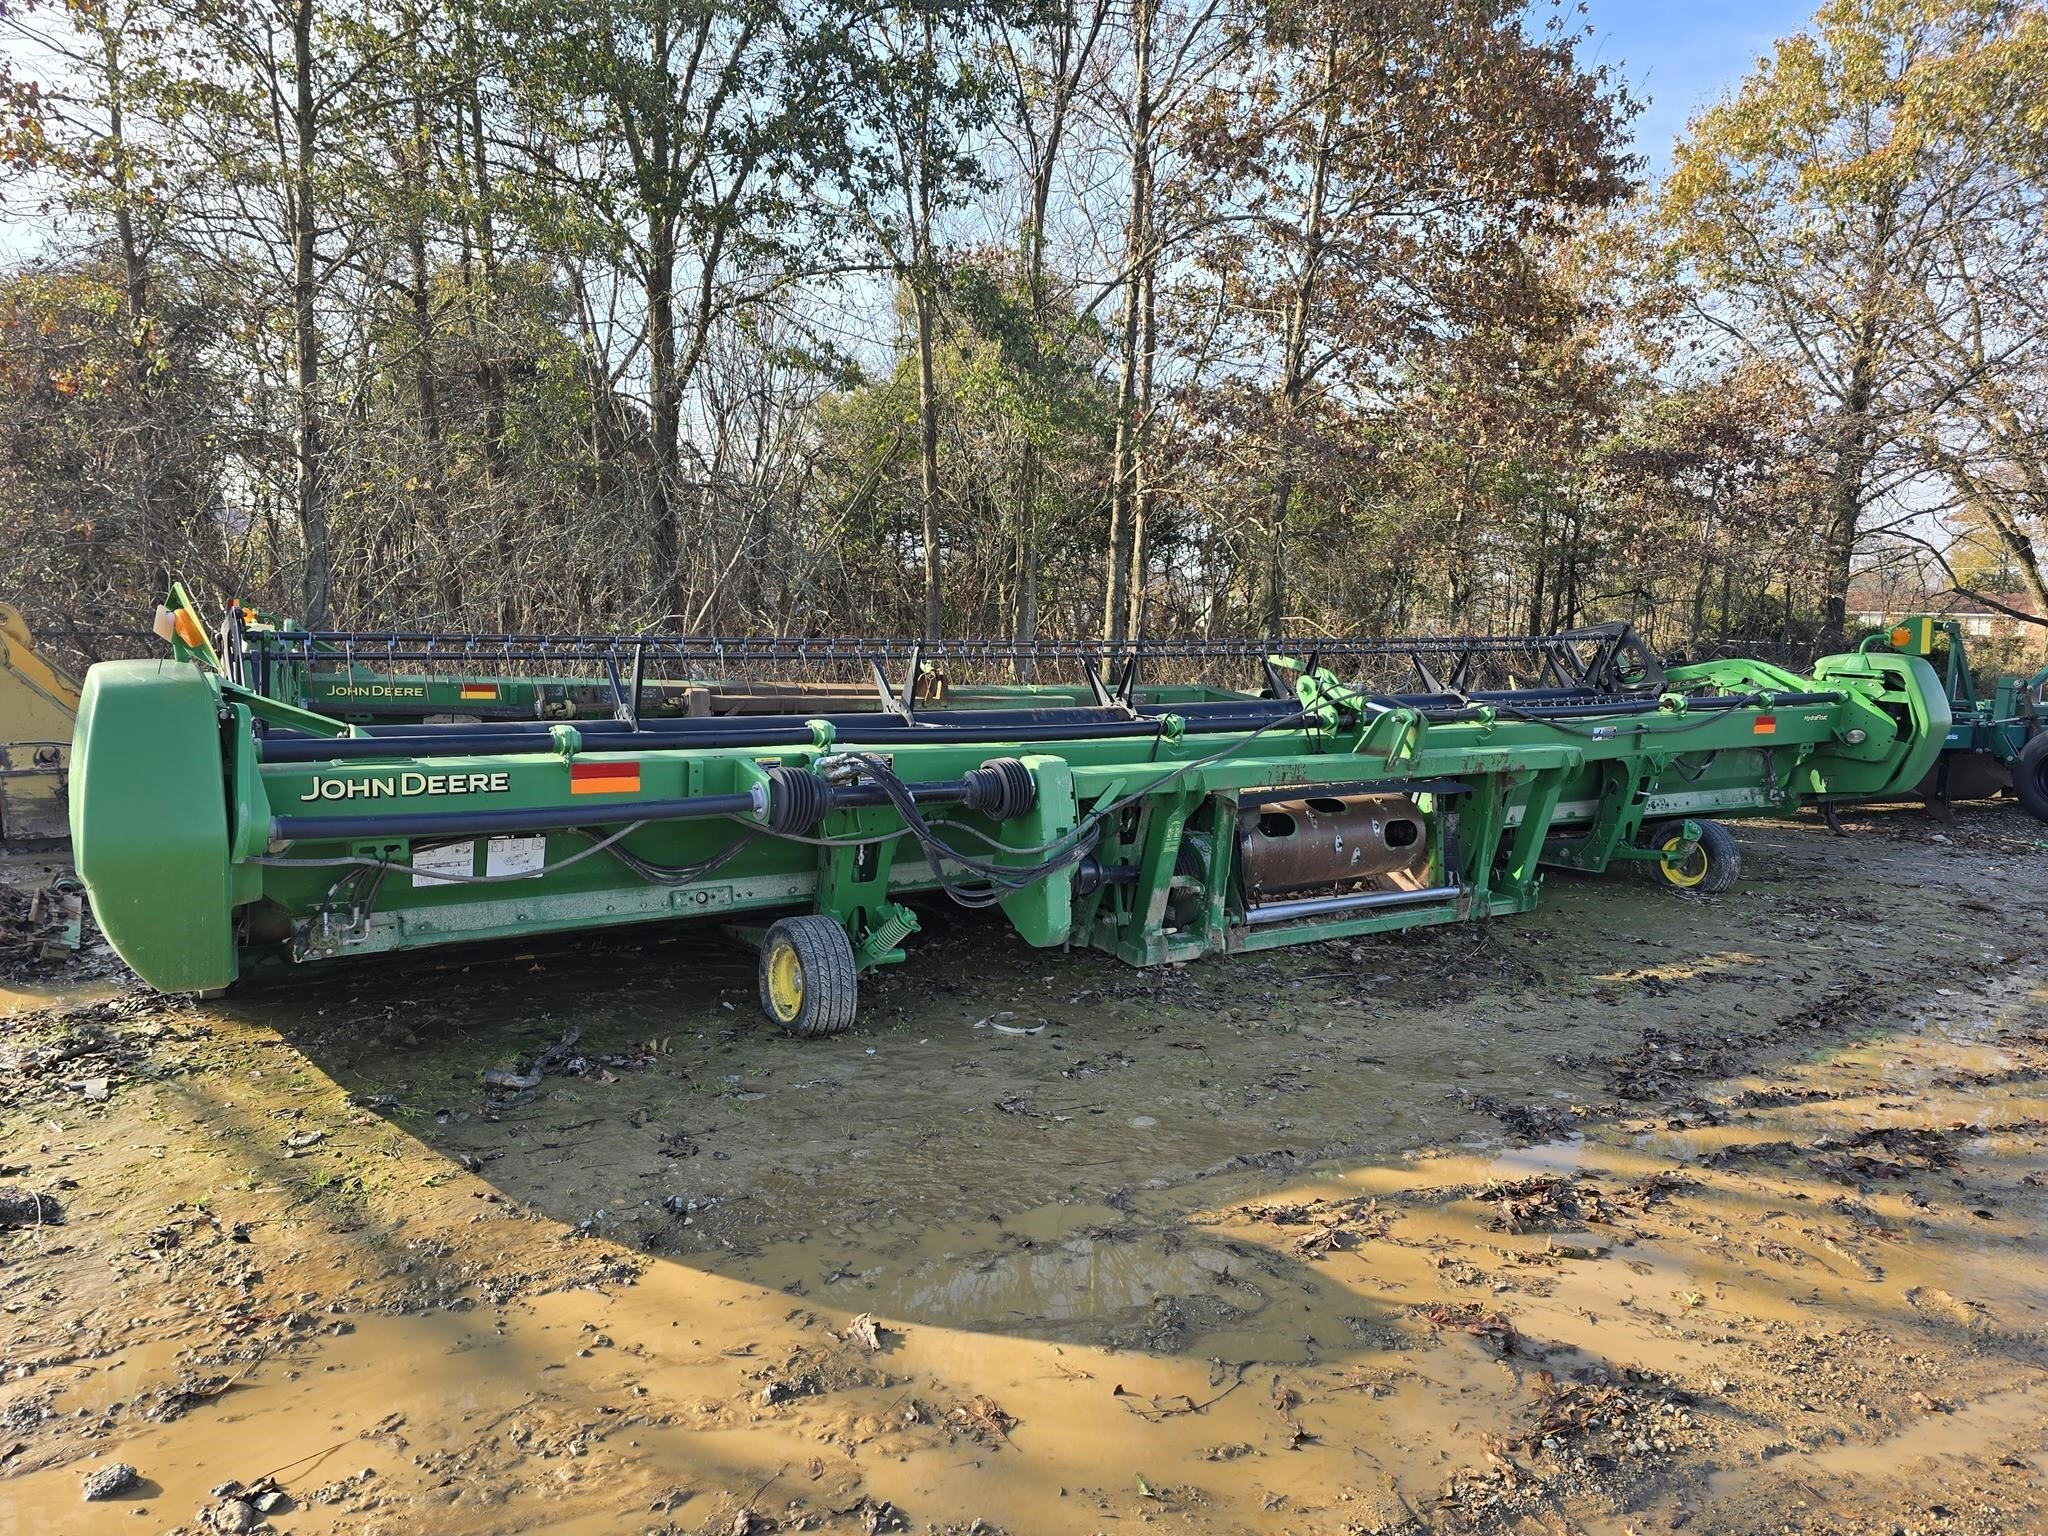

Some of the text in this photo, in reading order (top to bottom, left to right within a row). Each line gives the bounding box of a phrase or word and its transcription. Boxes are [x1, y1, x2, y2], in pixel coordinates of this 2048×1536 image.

[326, 685, 424, 697] JOHN DEERE
[300, 772, 510, 801] JOHN DEERE
